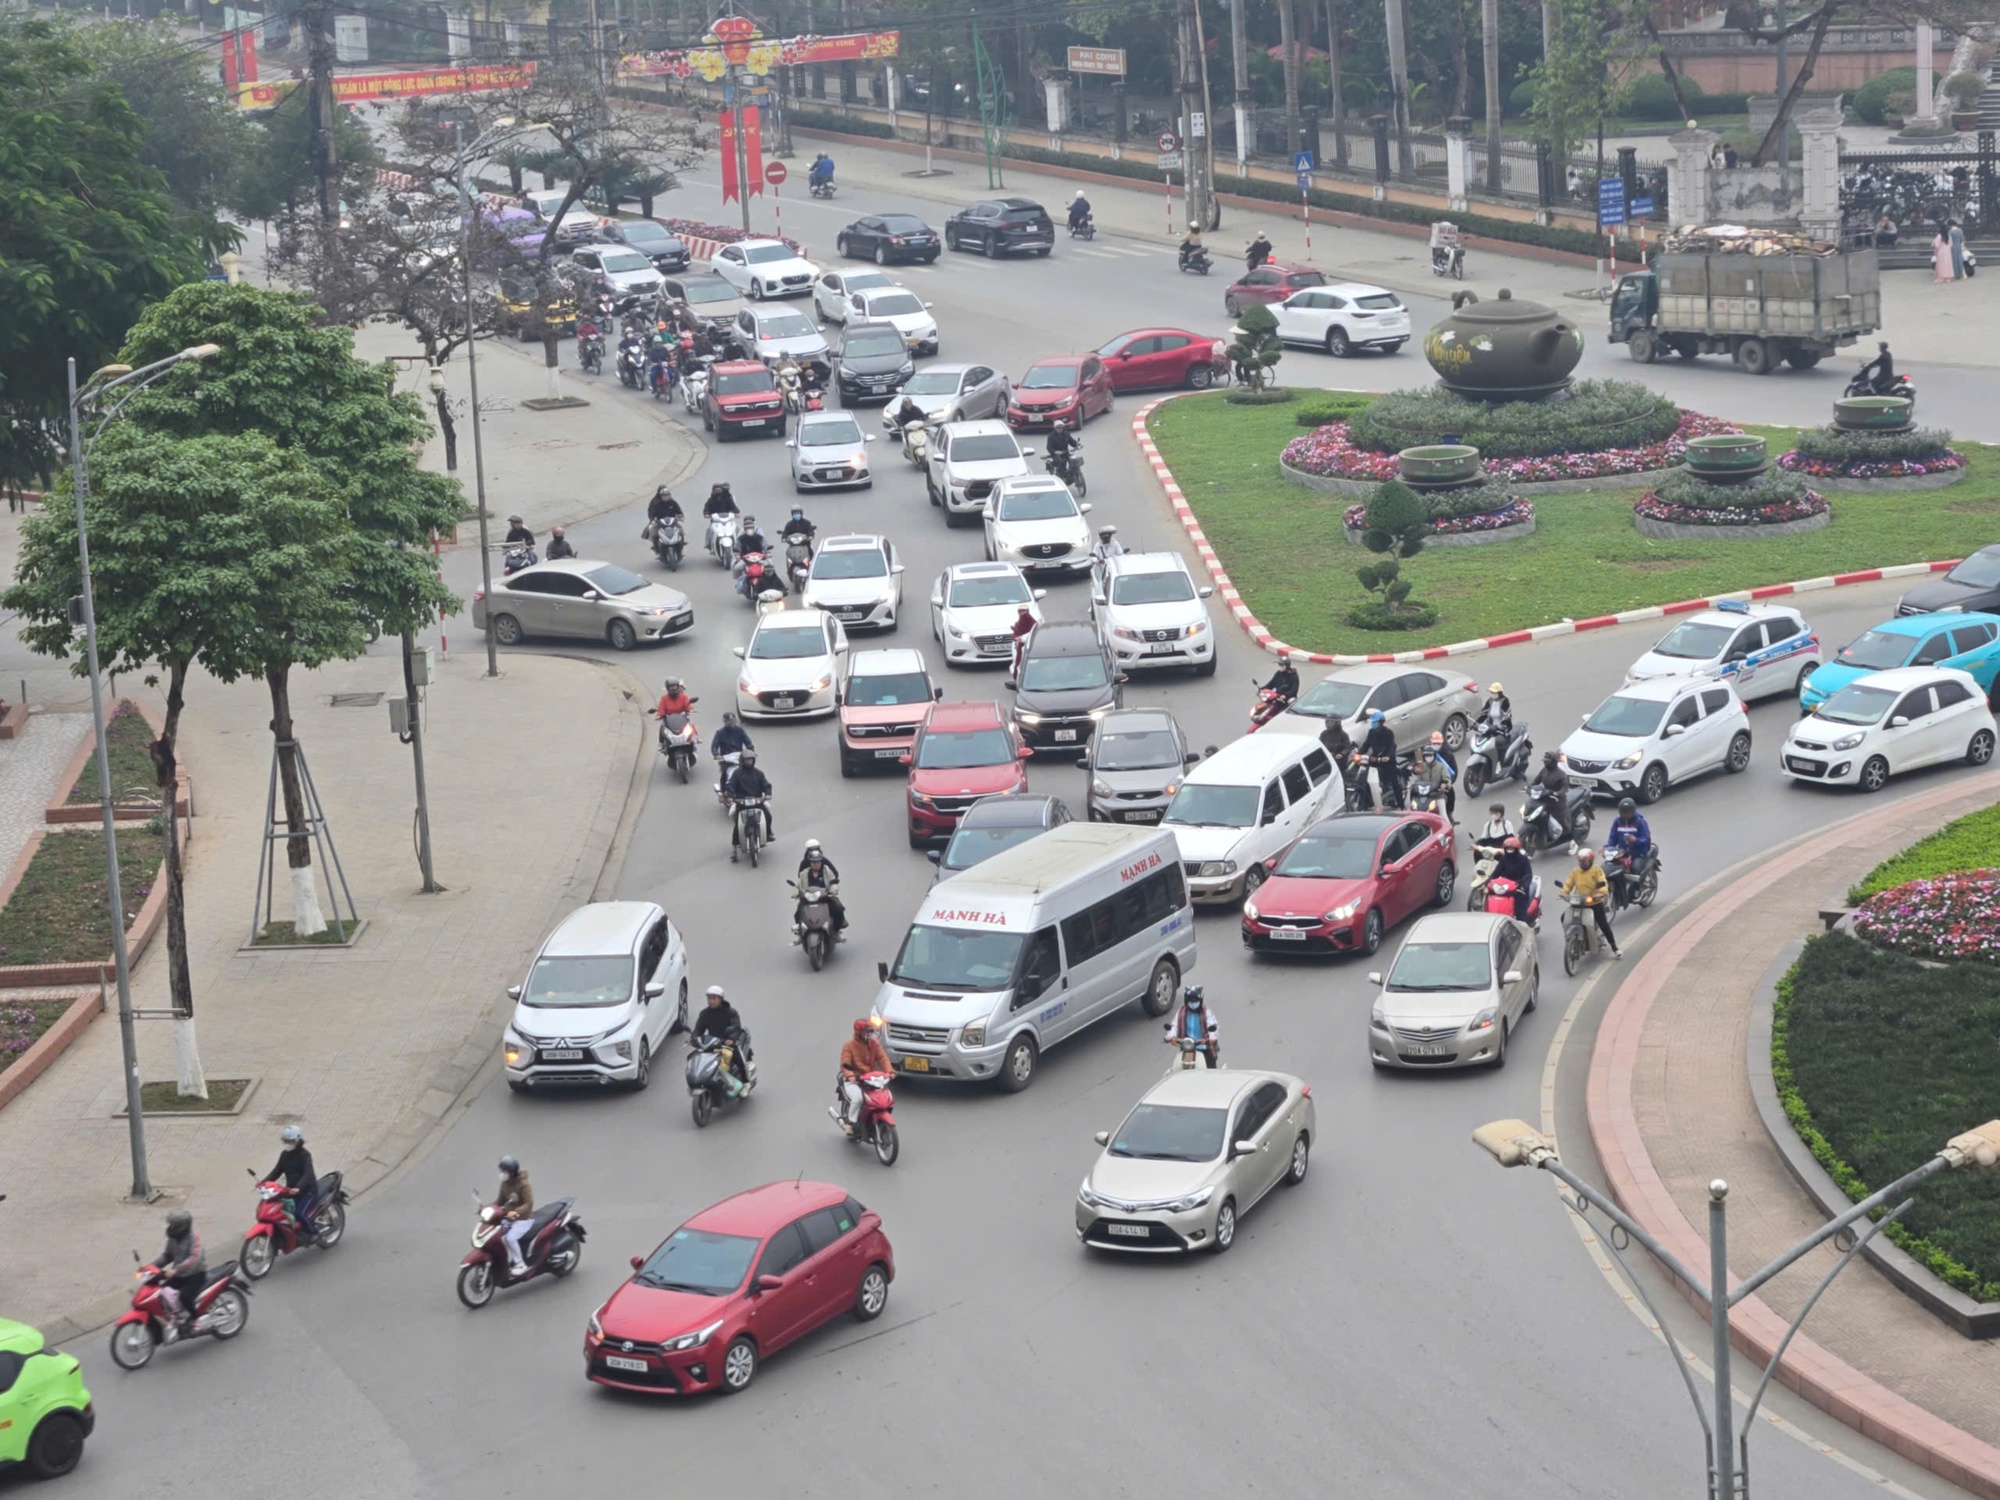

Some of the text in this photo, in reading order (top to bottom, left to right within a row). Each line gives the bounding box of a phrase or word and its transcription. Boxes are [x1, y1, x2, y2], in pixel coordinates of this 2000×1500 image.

[1120, 851, 1162, 882] MẠNH HÀ
[933, 909, 1006, 926] MẠNH HÀ
